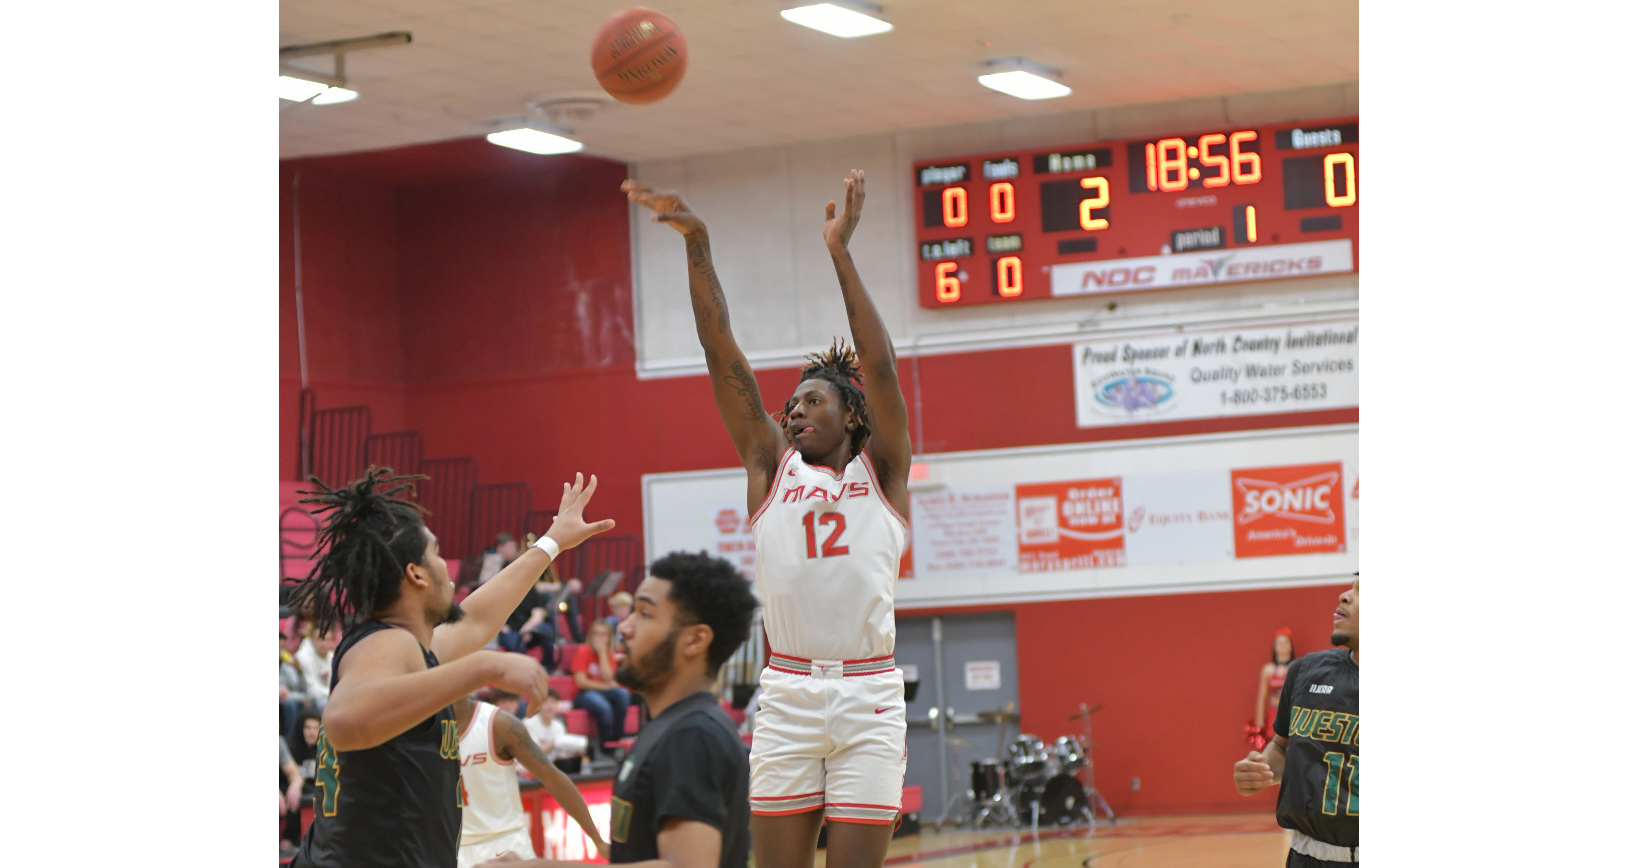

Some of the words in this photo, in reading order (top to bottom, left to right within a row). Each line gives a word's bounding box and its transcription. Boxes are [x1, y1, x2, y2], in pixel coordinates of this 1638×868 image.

[1292, 128, 1342, 149] Guests
[1145, 130, 1262, 192] 18:56
[1323, 152, 1356, 207] 0
[942, 187, 968, 228] 0
[989, 181, 1015, 223] 0
[1079, 176, 1110, 230] 2
[1175, 226, 1220, 251] period
[1246, 205, 1257, 242] 1
[935, 261, 961, 303] 6
[997, 256, 1023, 298] 0
[1081, 264, 1156, 289] NOC
[1171, 253, 1323, 283] MAVERICKS
[1082, 344, 1118, 364] Proud
[1123, 342, 1170, 364] Sponsor
[1175, 338, 1188, 357] of
[1193, 336, 1226, 356] North
[1233, 333, 1281, 354] Country
[1286, 325, 1357, 349] Invitational
[1191, 364, 1241, 383] Quality
[1246, 362, 1285, 379] Water
[1292, 357, 1353, 375] Services
[780, 481, 869, 503] MAVS
[1061, 498, 1120, 518] ONLINE
[1067, 486, 1115, 501] Order
[1244, 484, 1331, 514] SONIC
[802, 510, 850, 559] 12
